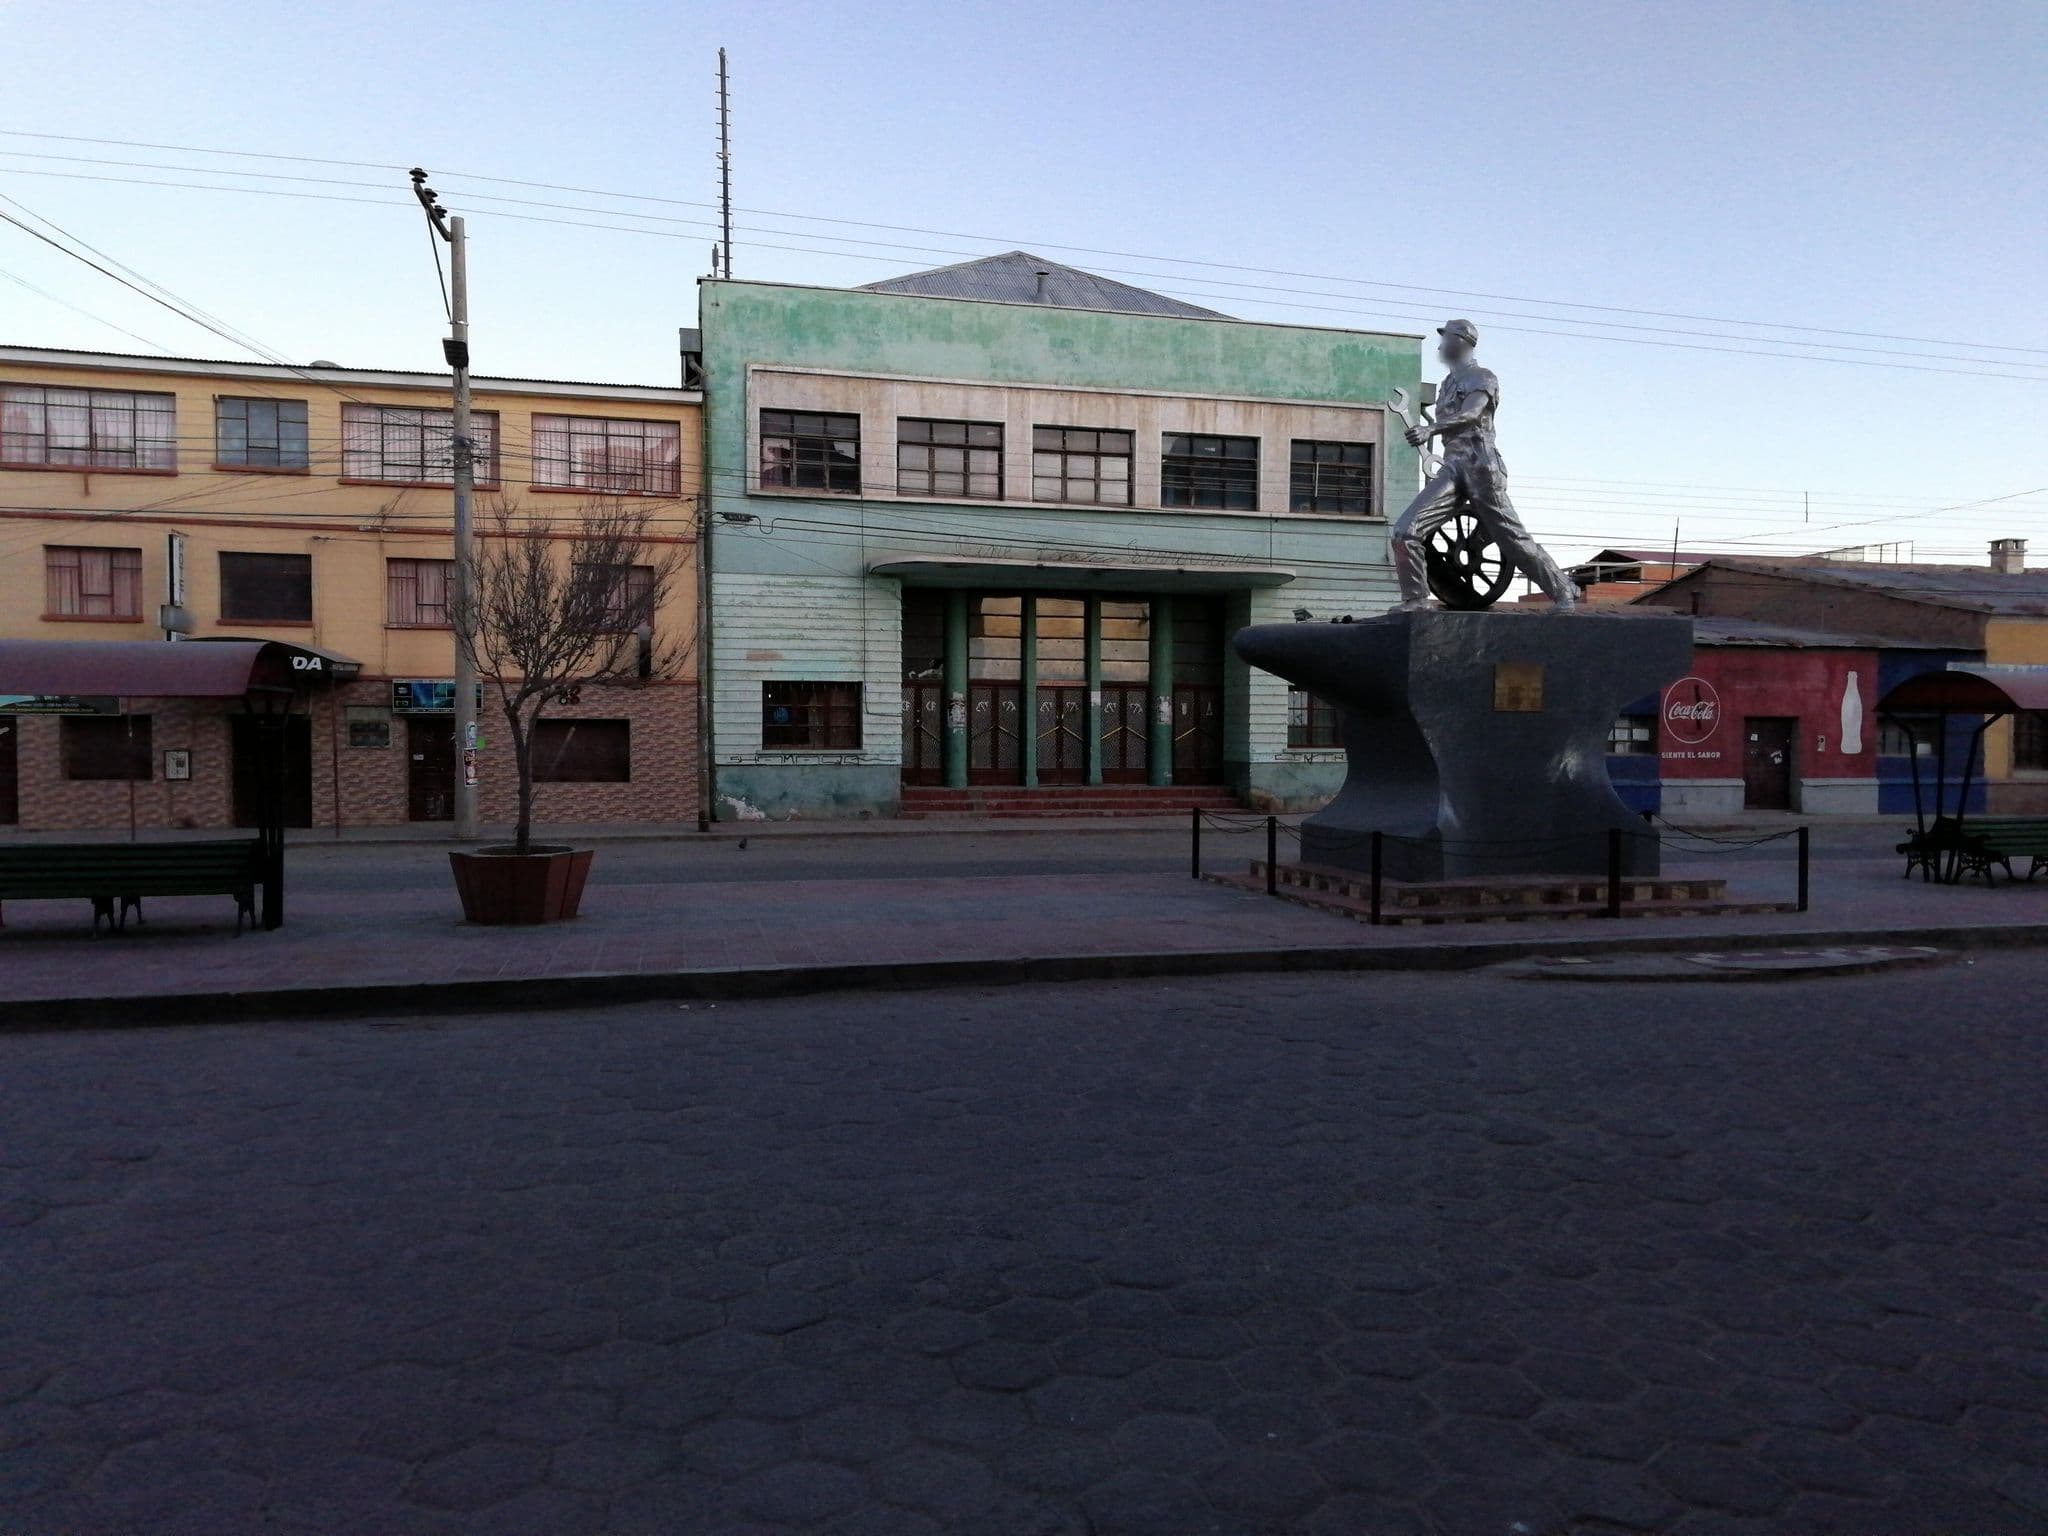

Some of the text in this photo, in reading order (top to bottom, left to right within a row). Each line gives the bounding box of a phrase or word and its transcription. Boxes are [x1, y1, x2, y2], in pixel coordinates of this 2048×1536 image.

[289, 655, 323, 671] DA
[1668, 701, 1716, 720] Coca-Cola
[1661, 751, 1721, 759] SIENTE EL SABOR
